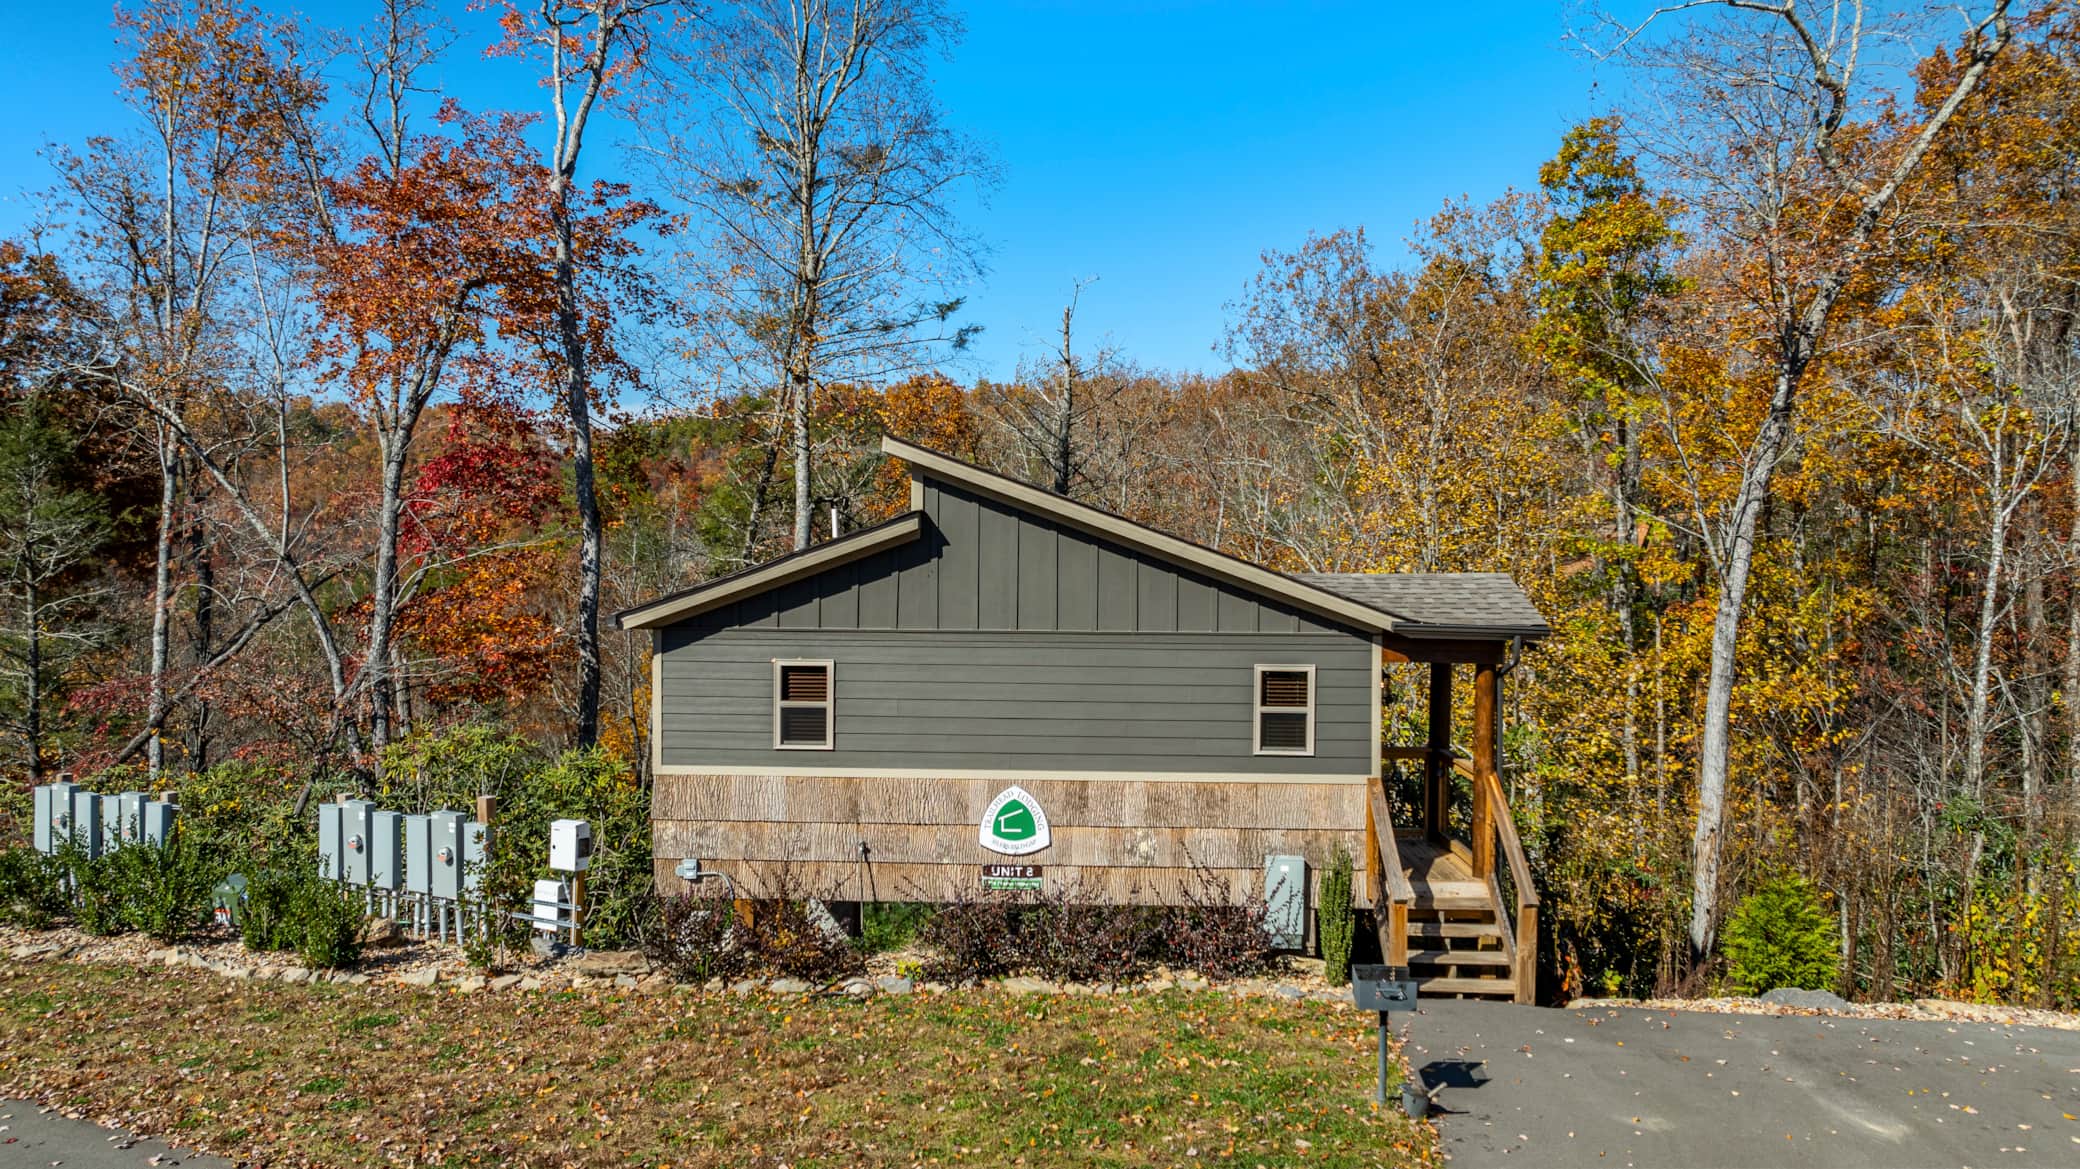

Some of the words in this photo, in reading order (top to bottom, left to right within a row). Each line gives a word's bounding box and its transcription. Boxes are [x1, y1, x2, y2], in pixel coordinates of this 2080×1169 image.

[984, 791, 1014, 828] TRAILHEAD
[1017, 791, 1045, 830] LODGING
[991, 866, 1023, 877] UNIT
[1026, 866, 1033, 877] 8
